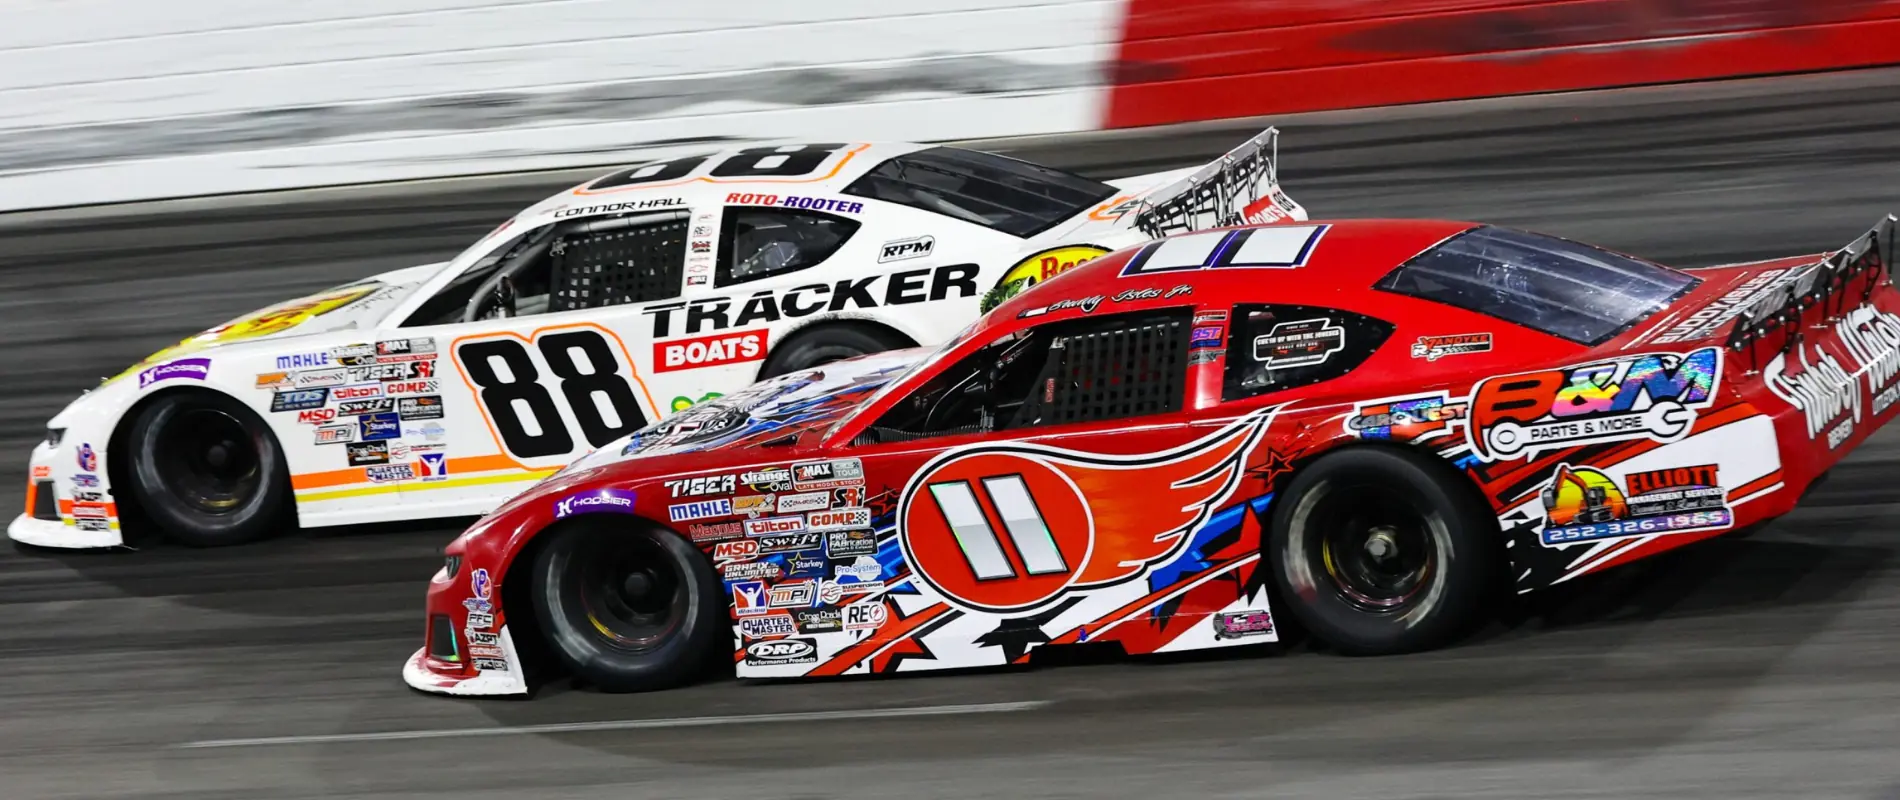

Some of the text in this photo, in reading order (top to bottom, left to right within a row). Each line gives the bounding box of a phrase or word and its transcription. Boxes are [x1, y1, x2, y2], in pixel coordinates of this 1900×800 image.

[554, 197, 687, 218] CONNOR HALL
[725, 193, 864, 214] ROTO-ROOTER
[884, 241, 932, 257] RPM
[641, 262, 980, 338] TRACKER
[665, 335, 759, 368] BOATS
[277, 352, 328, 369] MAHLE
[388, 382, 427, 394] COMP
[459, 330, 649, 459] 88
[1474, 350, 1718, 456] B&M
[298, 409, 336, 423] MSD
[1531, 416, 1643, 440] PARTS & MORE
[741, 469, 790, 484] Strange
[836, 469, 860, 477] TOUR
[1628, 464, 1719, 496] ELLIOTT
[664, 474, 736, 498] TIGER
[770, 480, 792, 491] Oval
[574, 496, 632, 507] HOOSIER
[671, 500, 730, 520] MAHLE
[811, 512, 855, 526] COMP
[1549, 511, 1726, 541] 252-326-1965
[689, 522, 742, 536] Magnus
[750, 520, 800, 533] tilton
[928, 472, 1071, 583] 11
[830, 532, 848, 540] PRO
[715, 541, 758, 557] MSD
[725, 562, 769, 572] GRAFIX
[796, 560, 824, 570] Starkey
[724, 568, 779, 578] UNLIMITED
[742, 618, 790, 631] QUARTER
[752, 625, 793, 635] MASTER
[760, 643, 807, 656] DRP
[747, 658, 787, 666] Performance
